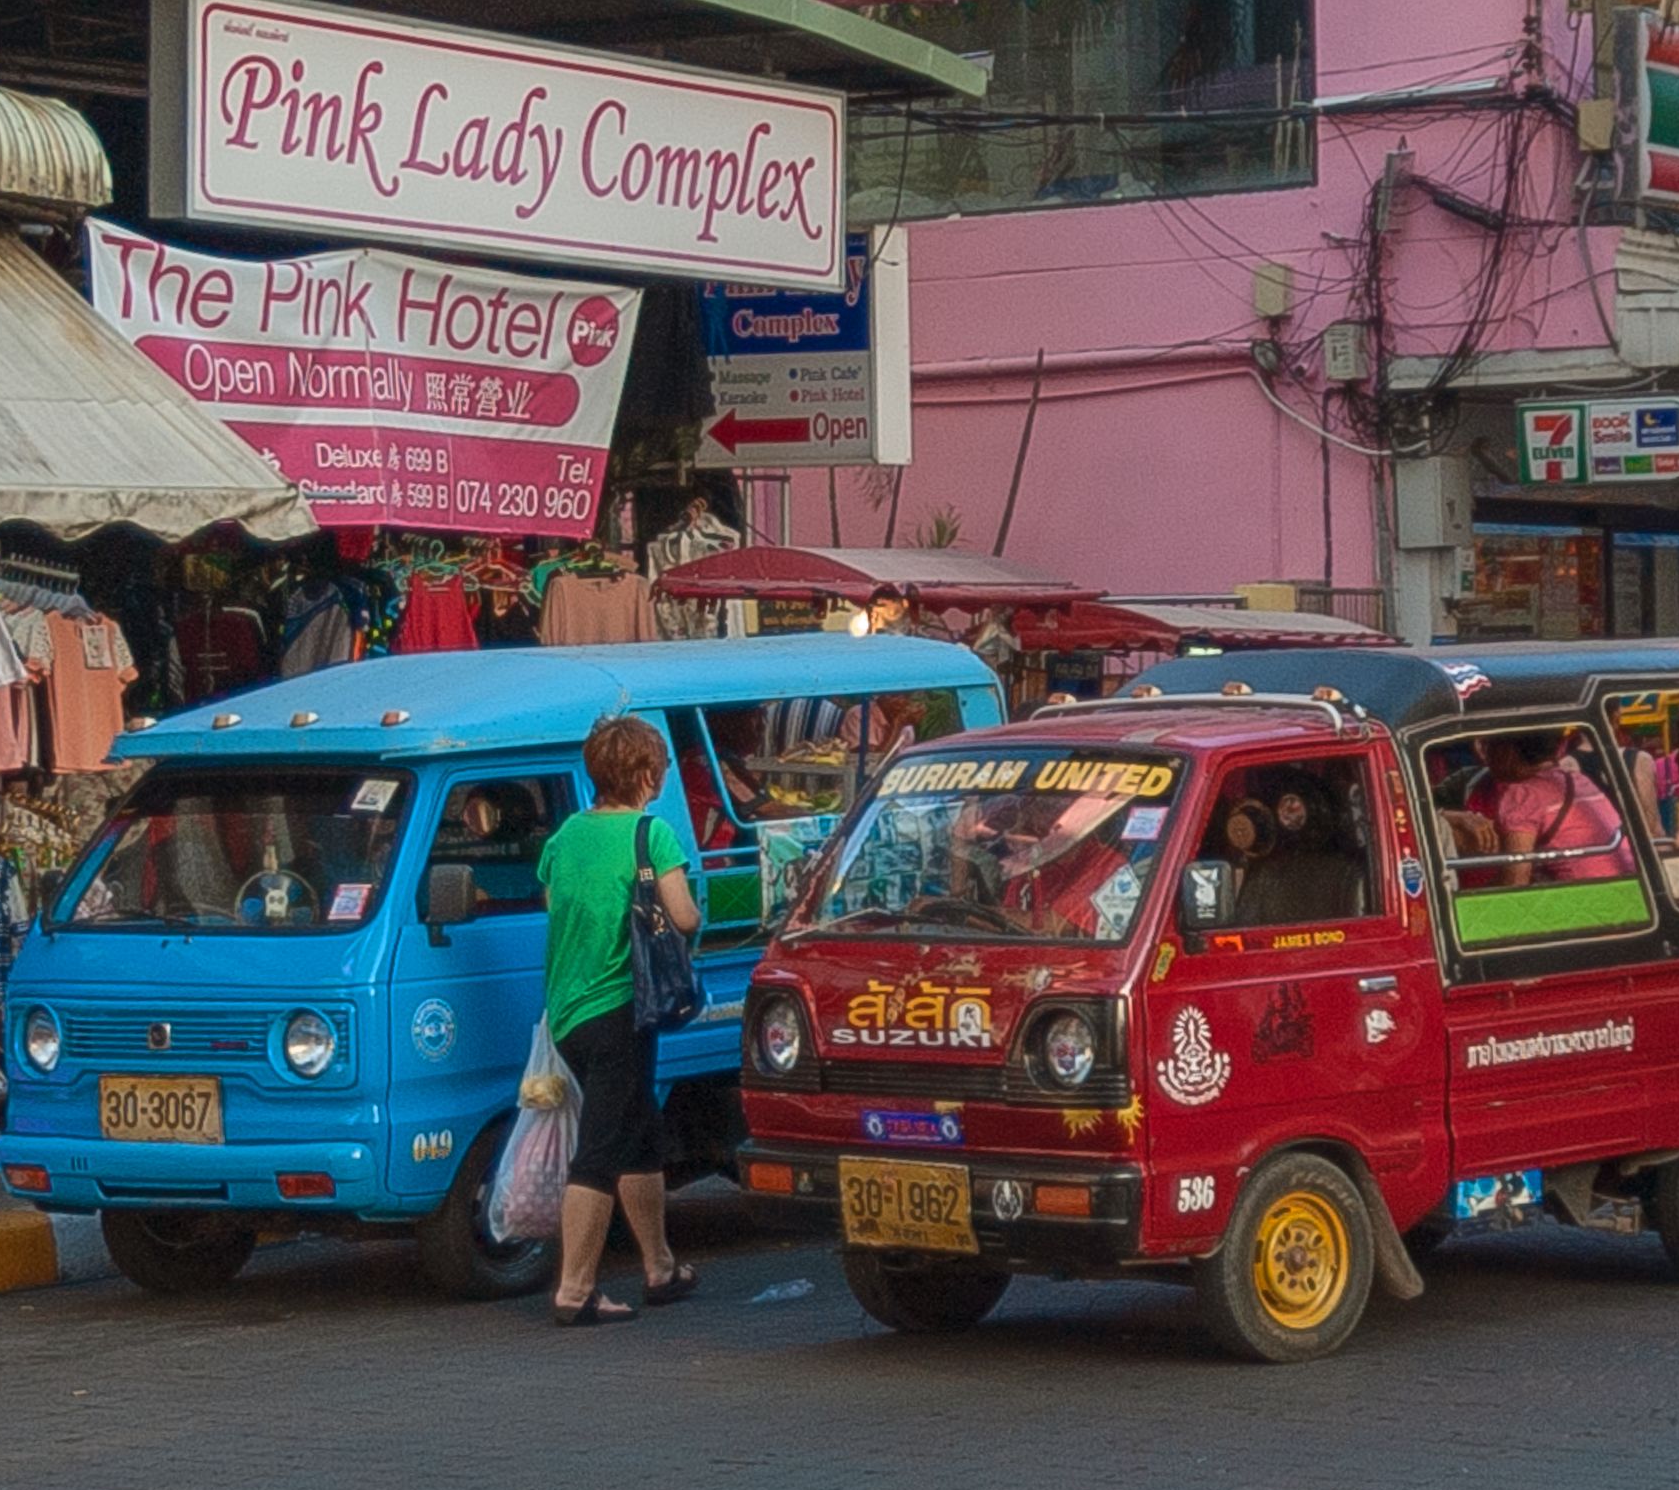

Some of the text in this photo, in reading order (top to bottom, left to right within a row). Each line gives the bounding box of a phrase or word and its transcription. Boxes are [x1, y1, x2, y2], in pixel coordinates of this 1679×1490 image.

[222, 56, 823, 242] Pink Lady Complex
[101, 235, 565, 360] The Pink Hotel
[572, 320, 617, 350] Pink
[732, 308, 841, 342] Complex
[184, 343, 414, 412] Open Normally
[800, 368, 826, 381] Pink
[801, 390, 828, 403] Pink
[832, 387, 865, 402] Hotel
[812, 411, 868, 447] Open
[315, 442, 383, 468] Deluxe
[405, 447, 432, 473] 699
[436, 449, 449, 474] B
[1532, 445, 1575, 460] ELEVEN
[558, 454, 594, 486] Tel.
[407, 483, 433, 509] 599
[437, 484, 449, 509] B
[456, 485, 592, 521] 074 230 960
[877, 759, 1174, 797] BURIRAM UNITED
[1314, 929, 1345, 945] BOND
[831, 1028, 992, 1048] SUZUKI
[106, 1089, 213, 1132] 30-3067
[847, 1175, 963, 1228] 30-1962
[1177, 1174, 1216, 1214] 536
